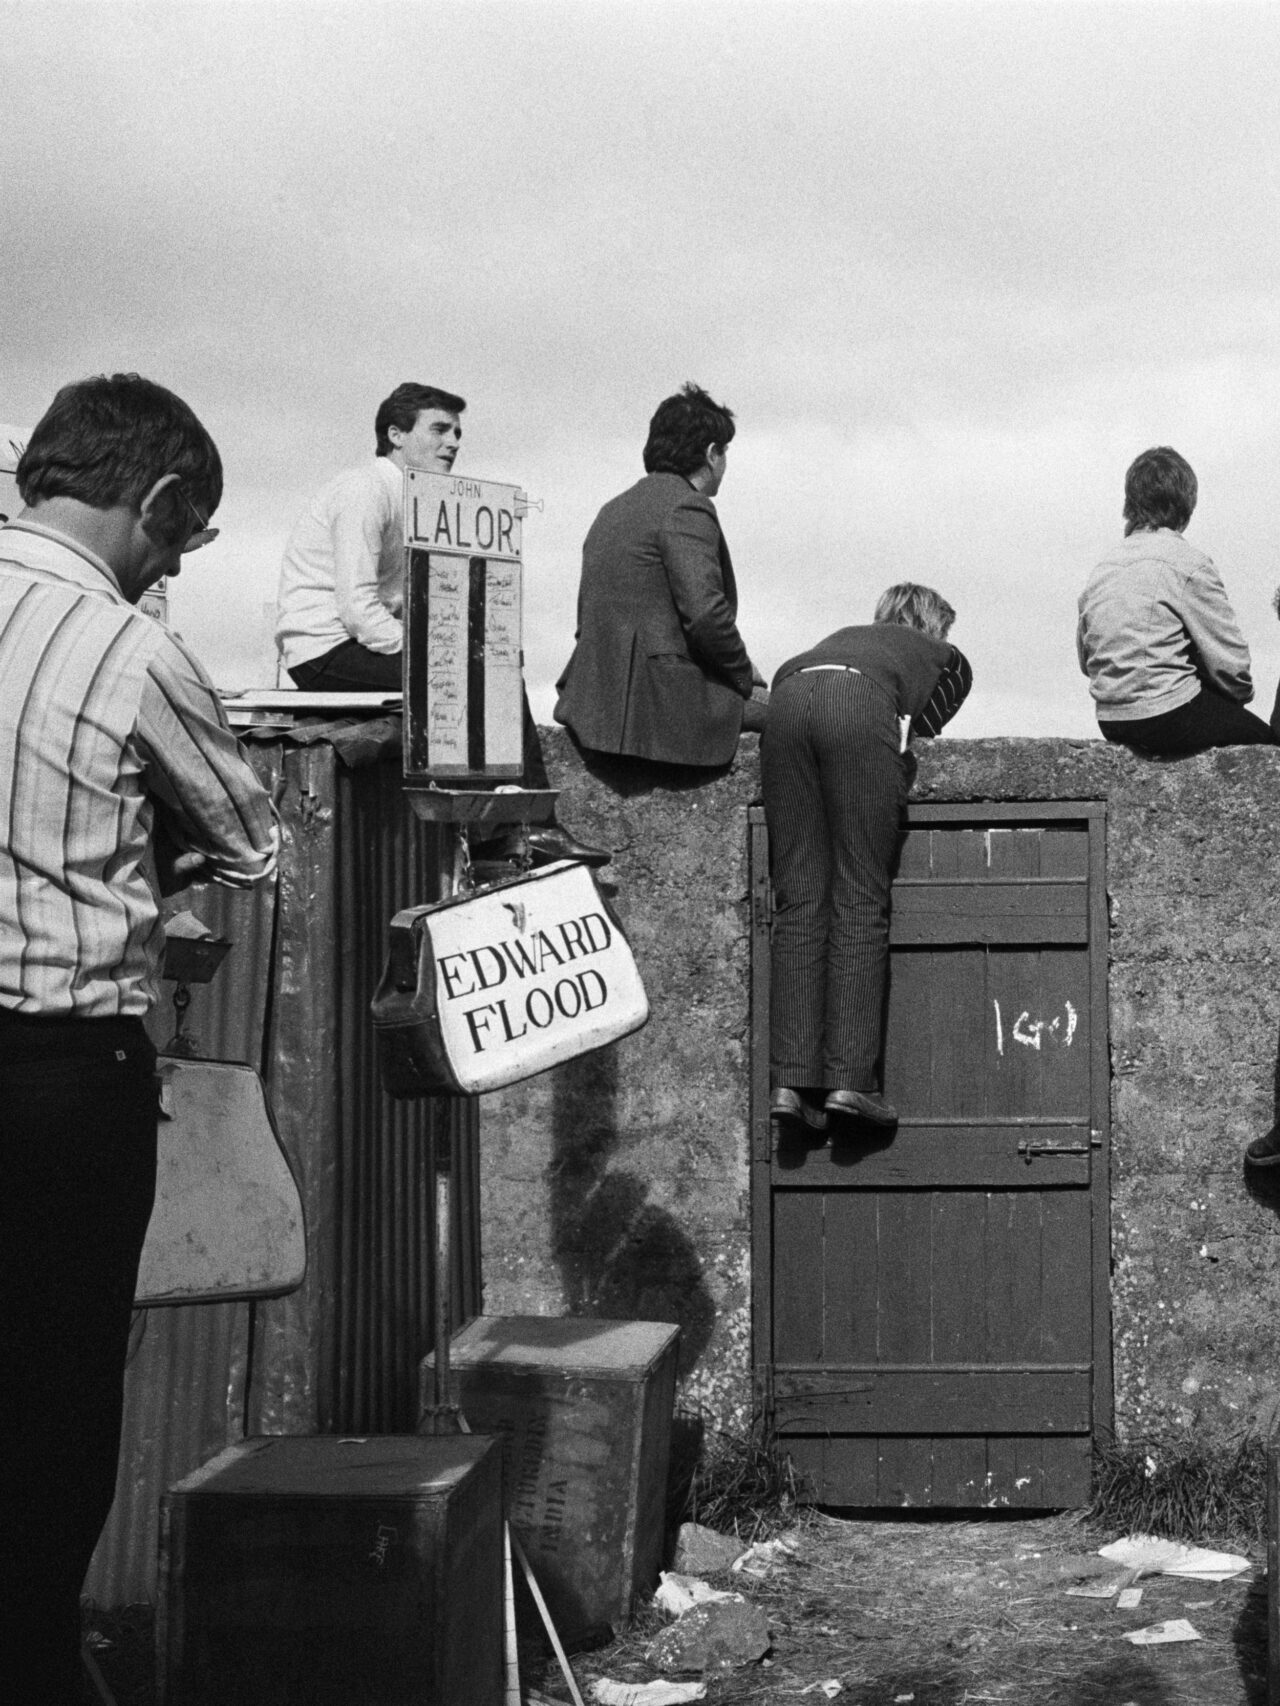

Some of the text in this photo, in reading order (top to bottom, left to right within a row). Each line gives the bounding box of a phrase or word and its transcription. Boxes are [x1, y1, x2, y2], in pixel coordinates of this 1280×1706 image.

[450, 479, 482, 498] JOHN
[413, 496, 514, 553] LALOR
[437, 912, 611, 1000] EDWARD
[463, 968, 608, 1054] FLOOD
